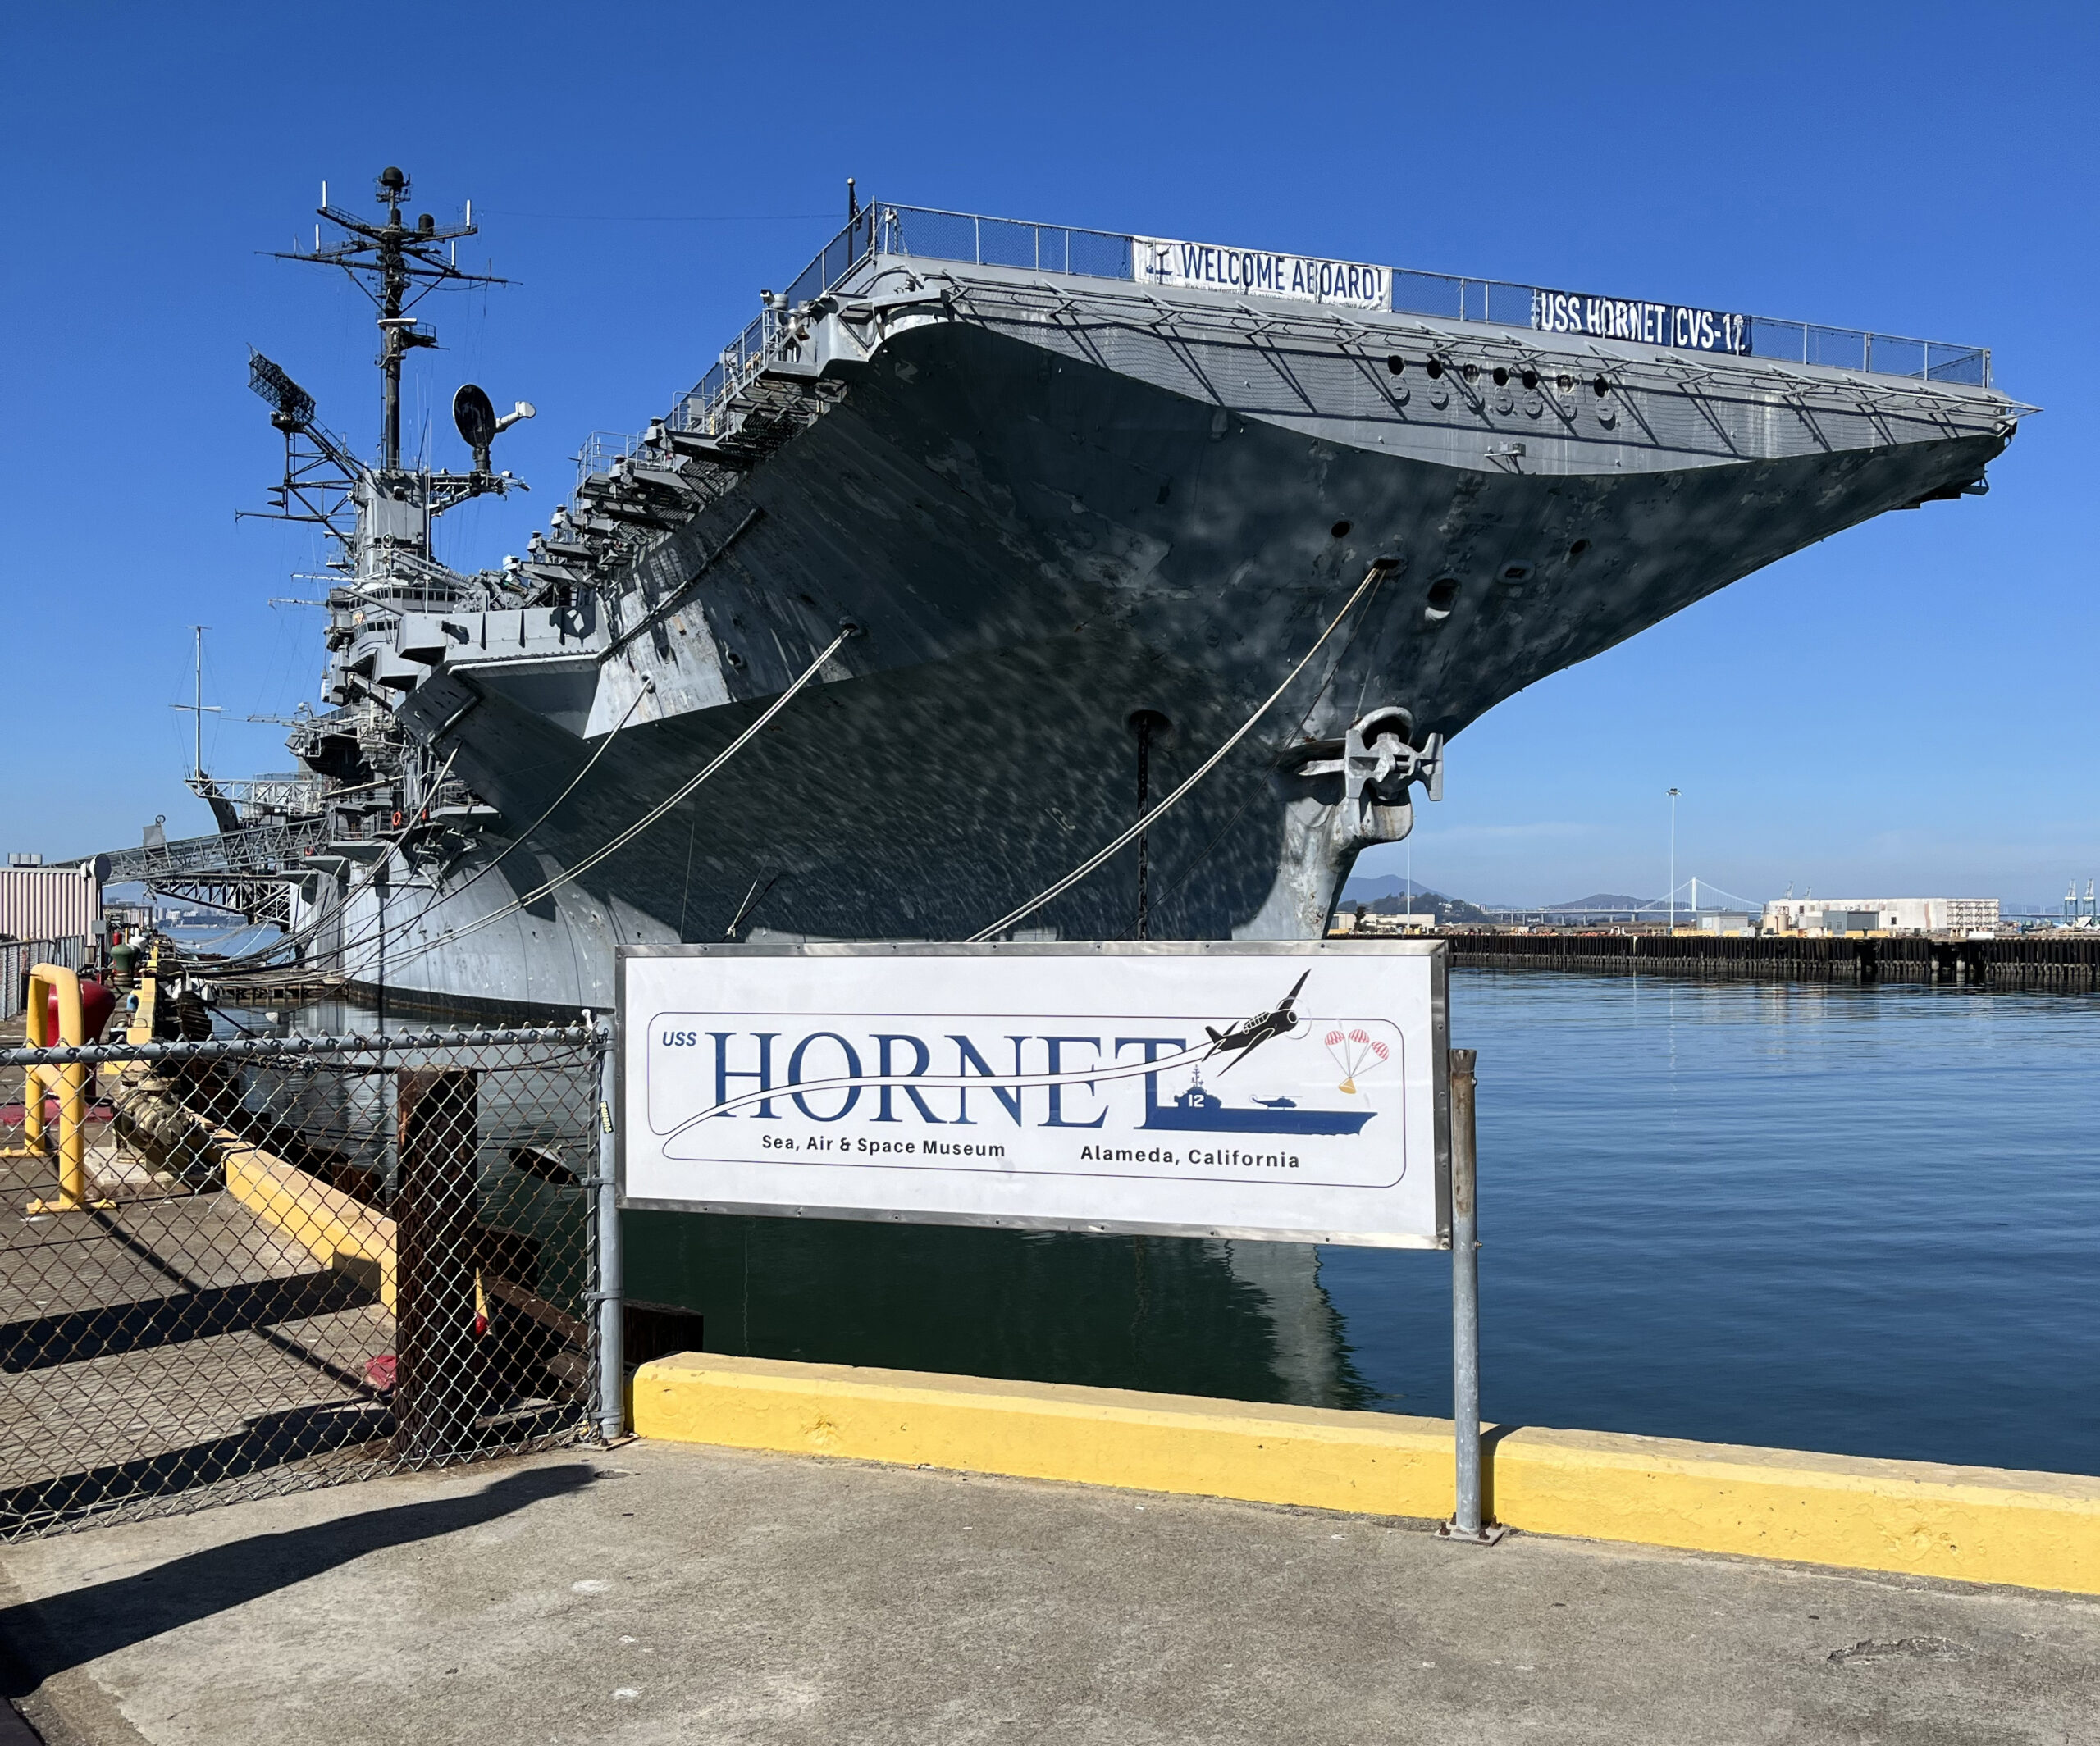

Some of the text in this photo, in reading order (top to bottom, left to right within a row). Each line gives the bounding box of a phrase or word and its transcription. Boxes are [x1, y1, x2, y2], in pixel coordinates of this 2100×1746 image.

[1181, 243, 1285, 290] WELCOME
[1291, 259, 1384, 301] ABOARD!
[1541, 292, 1746, 350] USS HORNET CVS-12
[662, 1031, 1187, 1130] USS HORNET
[1189, 1094, 1204, 1107] 12
[762, 1135, 1005, 1157] Sea, Air & Space Museum
[1081, 1146, 1299, 1168] Alameda, California
